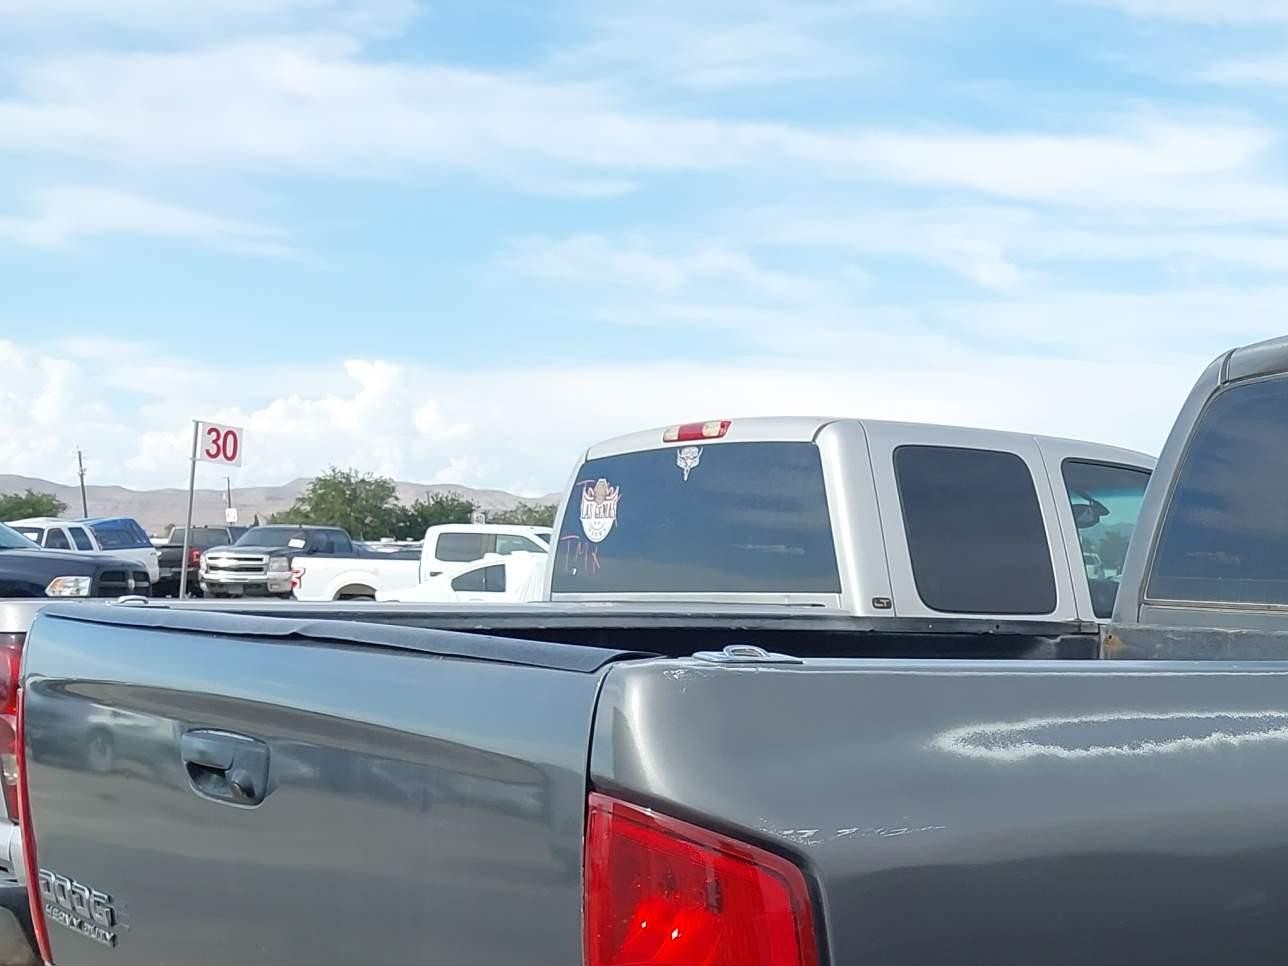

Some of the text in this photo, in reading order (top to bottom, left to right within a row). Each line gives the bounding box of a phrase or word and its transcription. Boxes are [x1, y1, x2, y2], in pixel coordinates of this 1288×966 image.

[205, 427, 238, 461] 30
[45, 903, 117, 948] HEAVY DUTY
